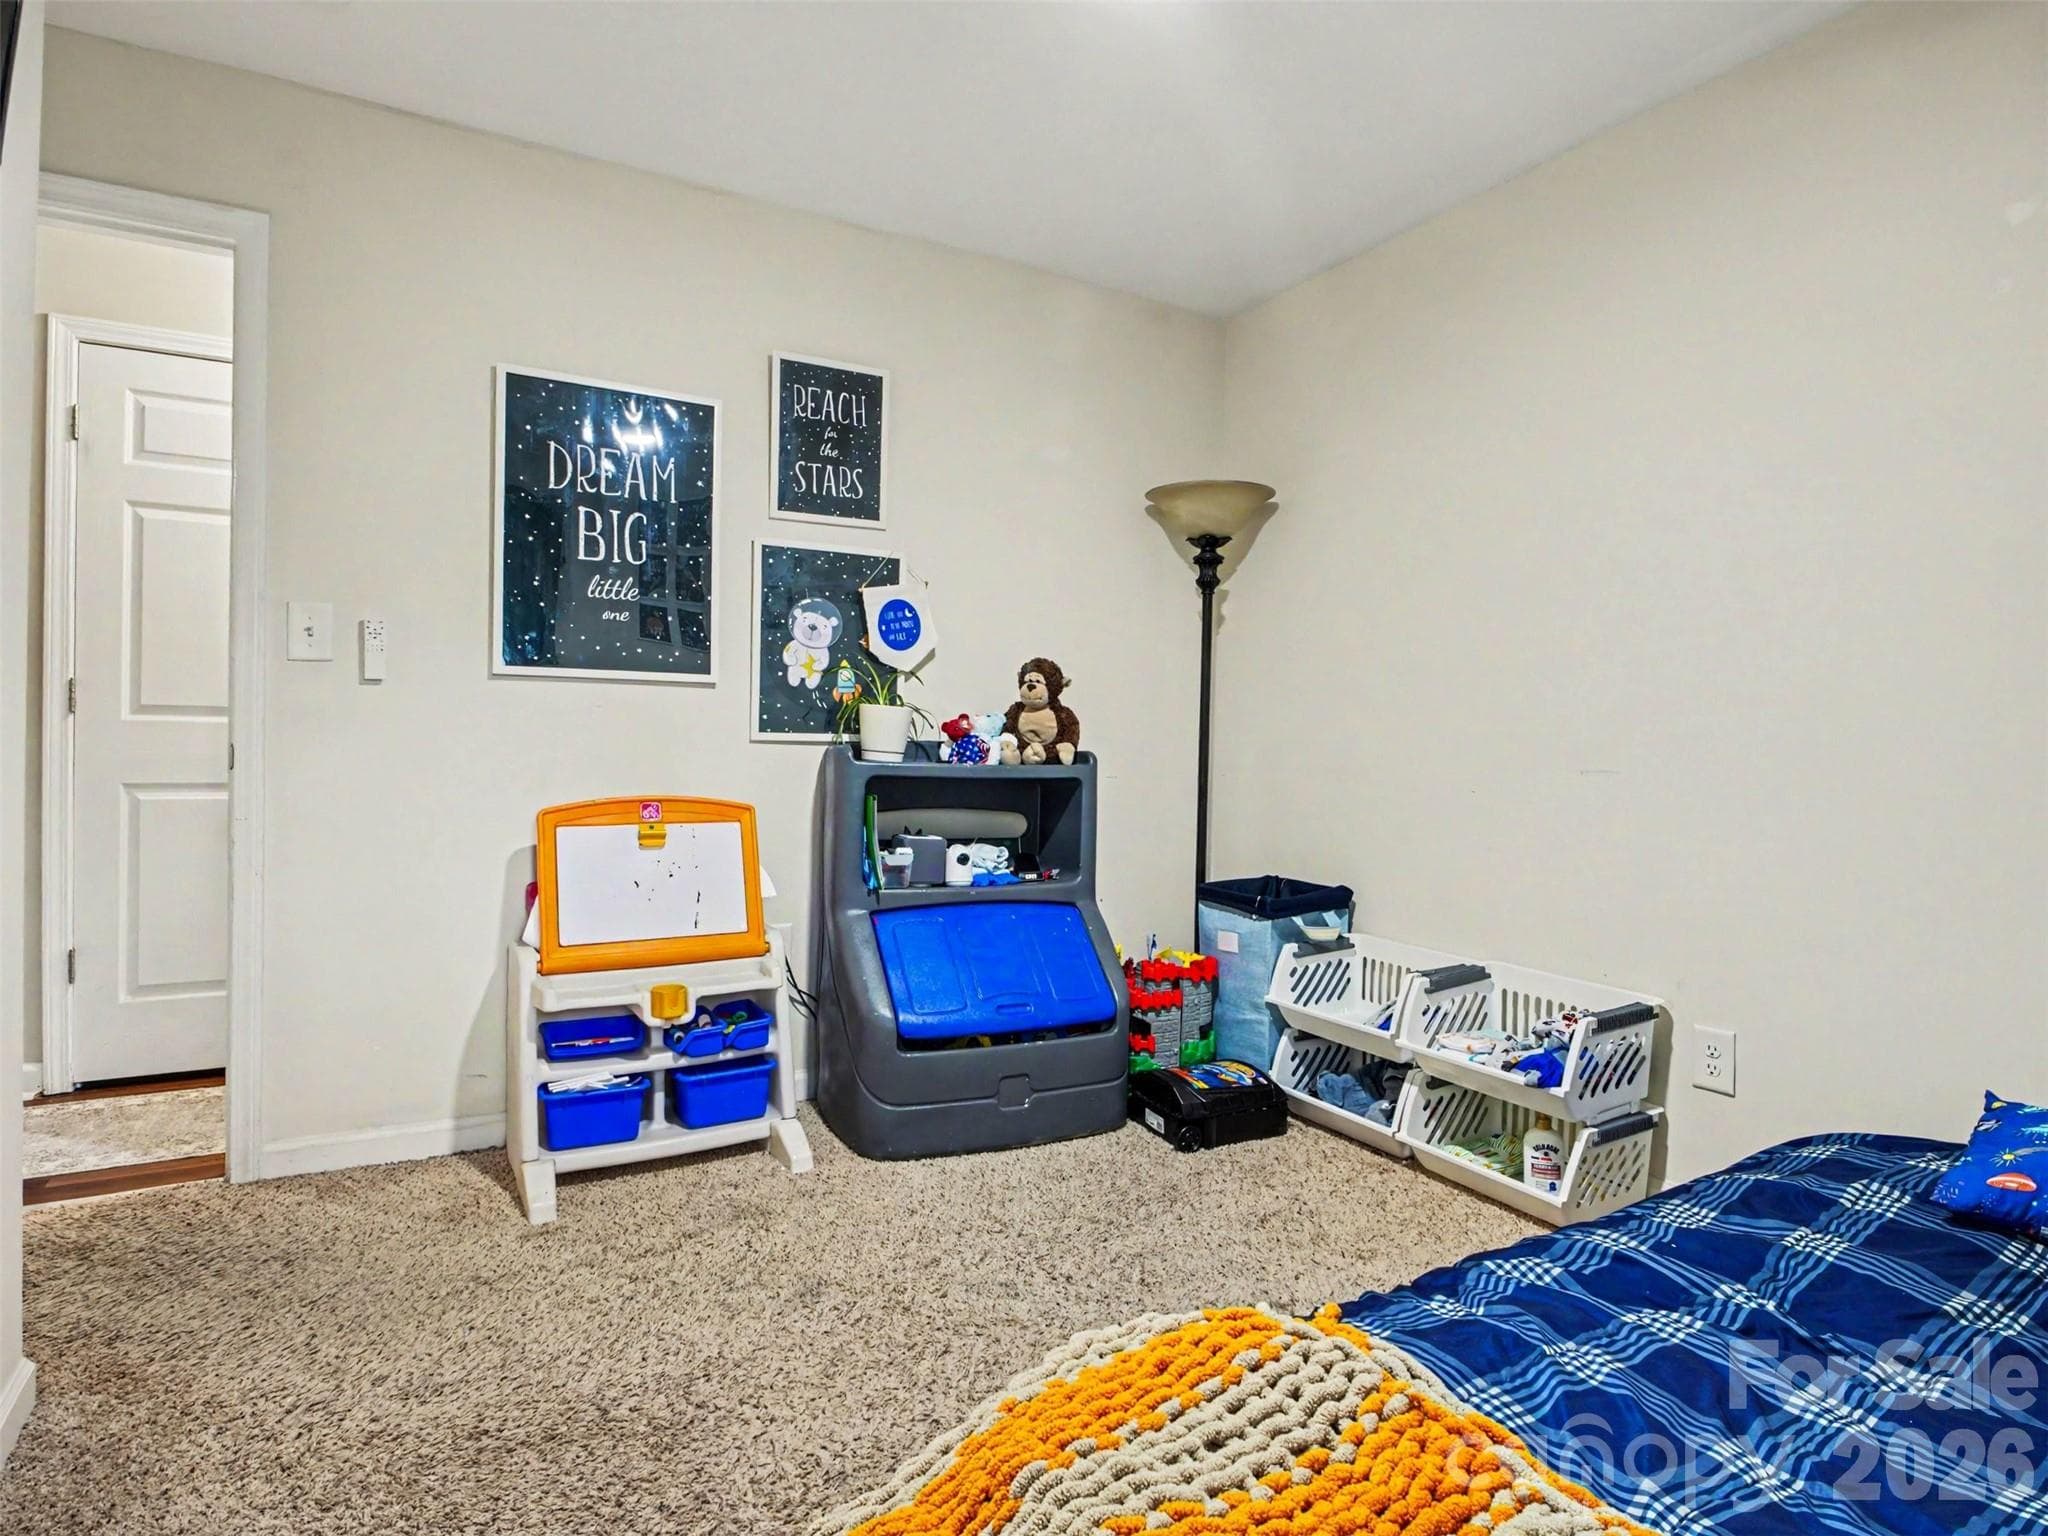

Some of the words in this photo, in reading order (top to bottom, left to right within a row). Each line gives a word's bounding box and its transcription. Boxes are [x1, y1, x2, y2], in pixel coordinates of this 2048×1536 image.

[793, 384, 867, 427] REACH
[824, 426, 838, 440] for
[820, 442, 839, 458] the
[547, 440, 677, 503] DREAM
[795, 461, 863, 499] STARS
[577, 505, 647, 565] BIG
[587, 574, 640, 601] little
[602, 609, 631, 622] one
